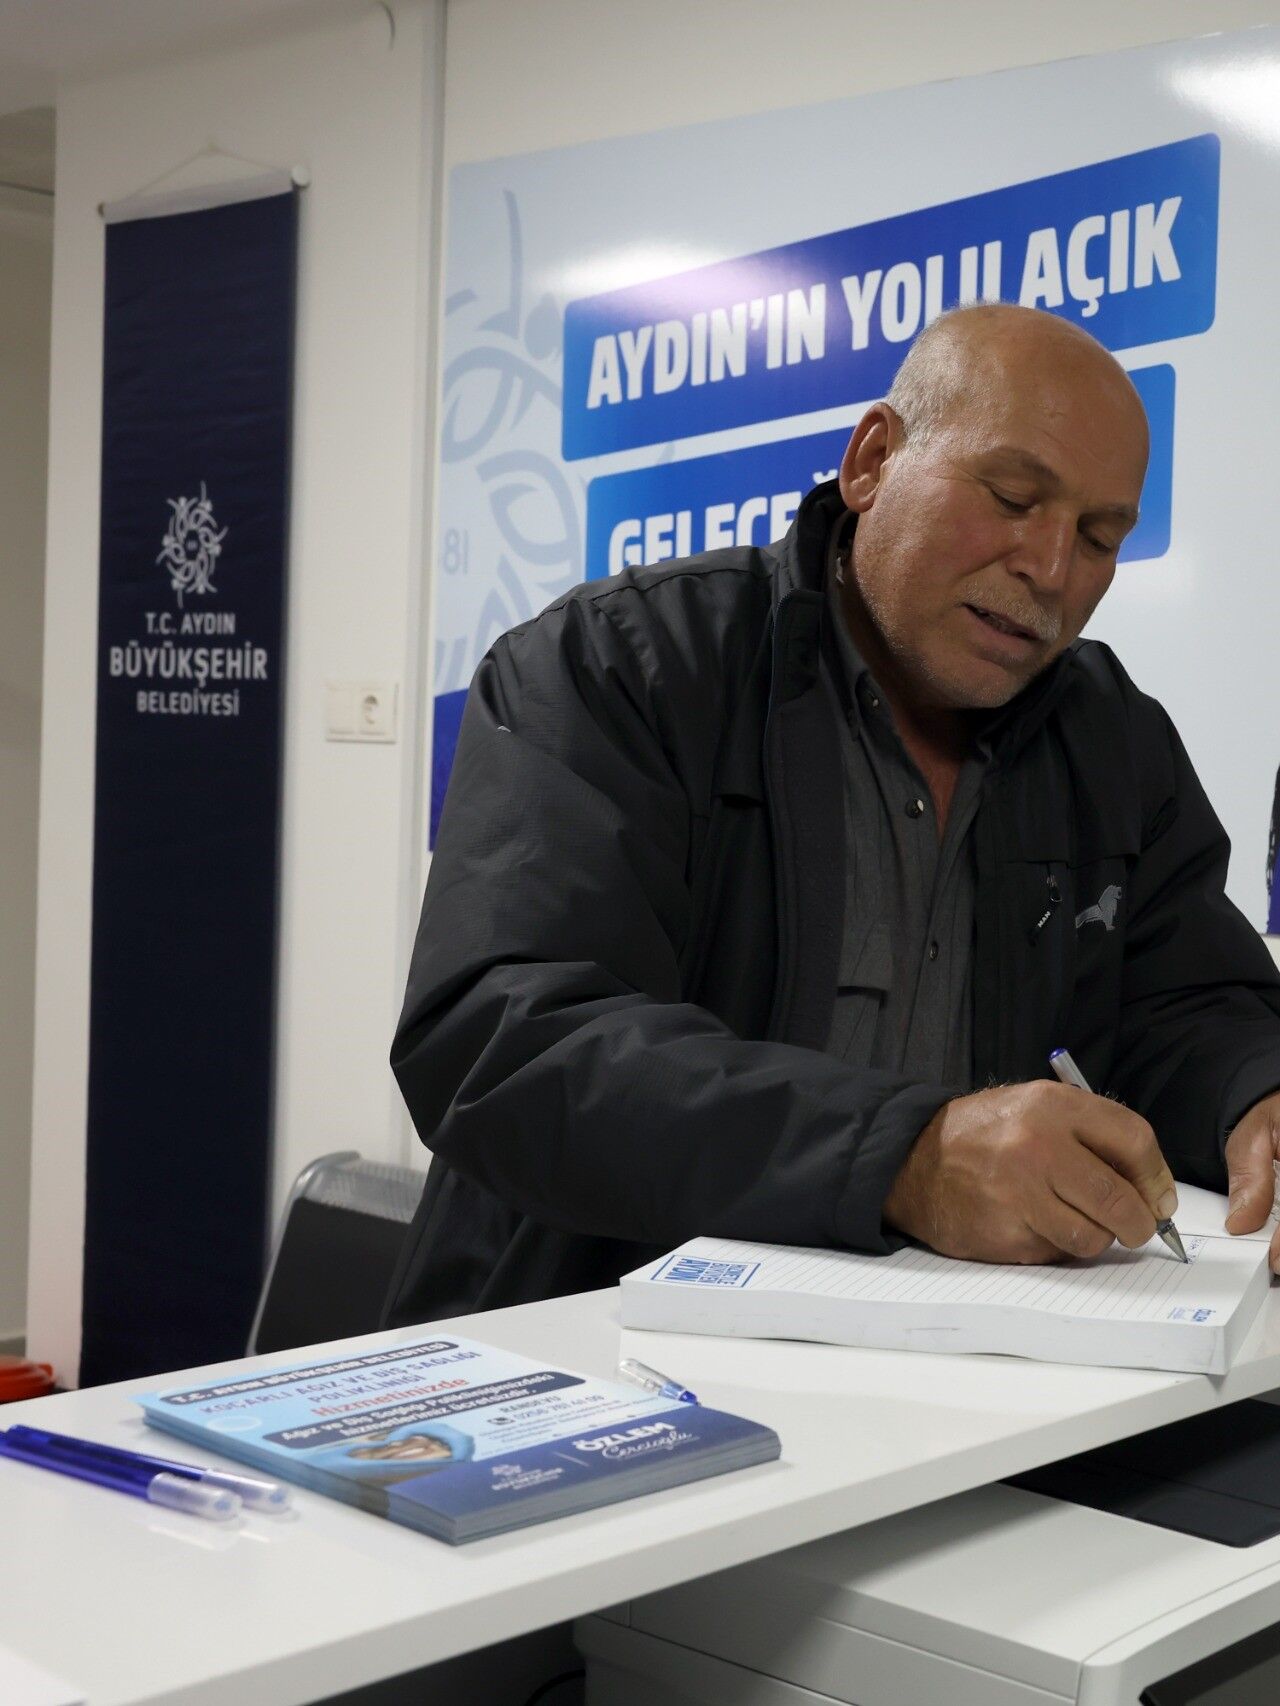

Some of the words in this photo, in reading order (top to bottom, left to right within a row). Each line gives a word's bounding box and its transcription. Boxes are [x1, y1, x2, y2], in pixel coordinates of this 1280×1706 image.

[585, 283, 826, 409] AYDIN'IN
[1018, 195, 1183, 318] AÇIK
[608, 469, 839, 577] GELECE
[145, 612, 177, 634] T.C.
[180, 612, 236, 635] AYDIN
[109, 640, 268, 688] BÜYÜKŞEHİR
[136, 689, 240, 716] BELEDİYESİ
[312, 1378, 470, 1416] Hizmetinizde
[572, 1421, 676, 1451] ÖZLEM
